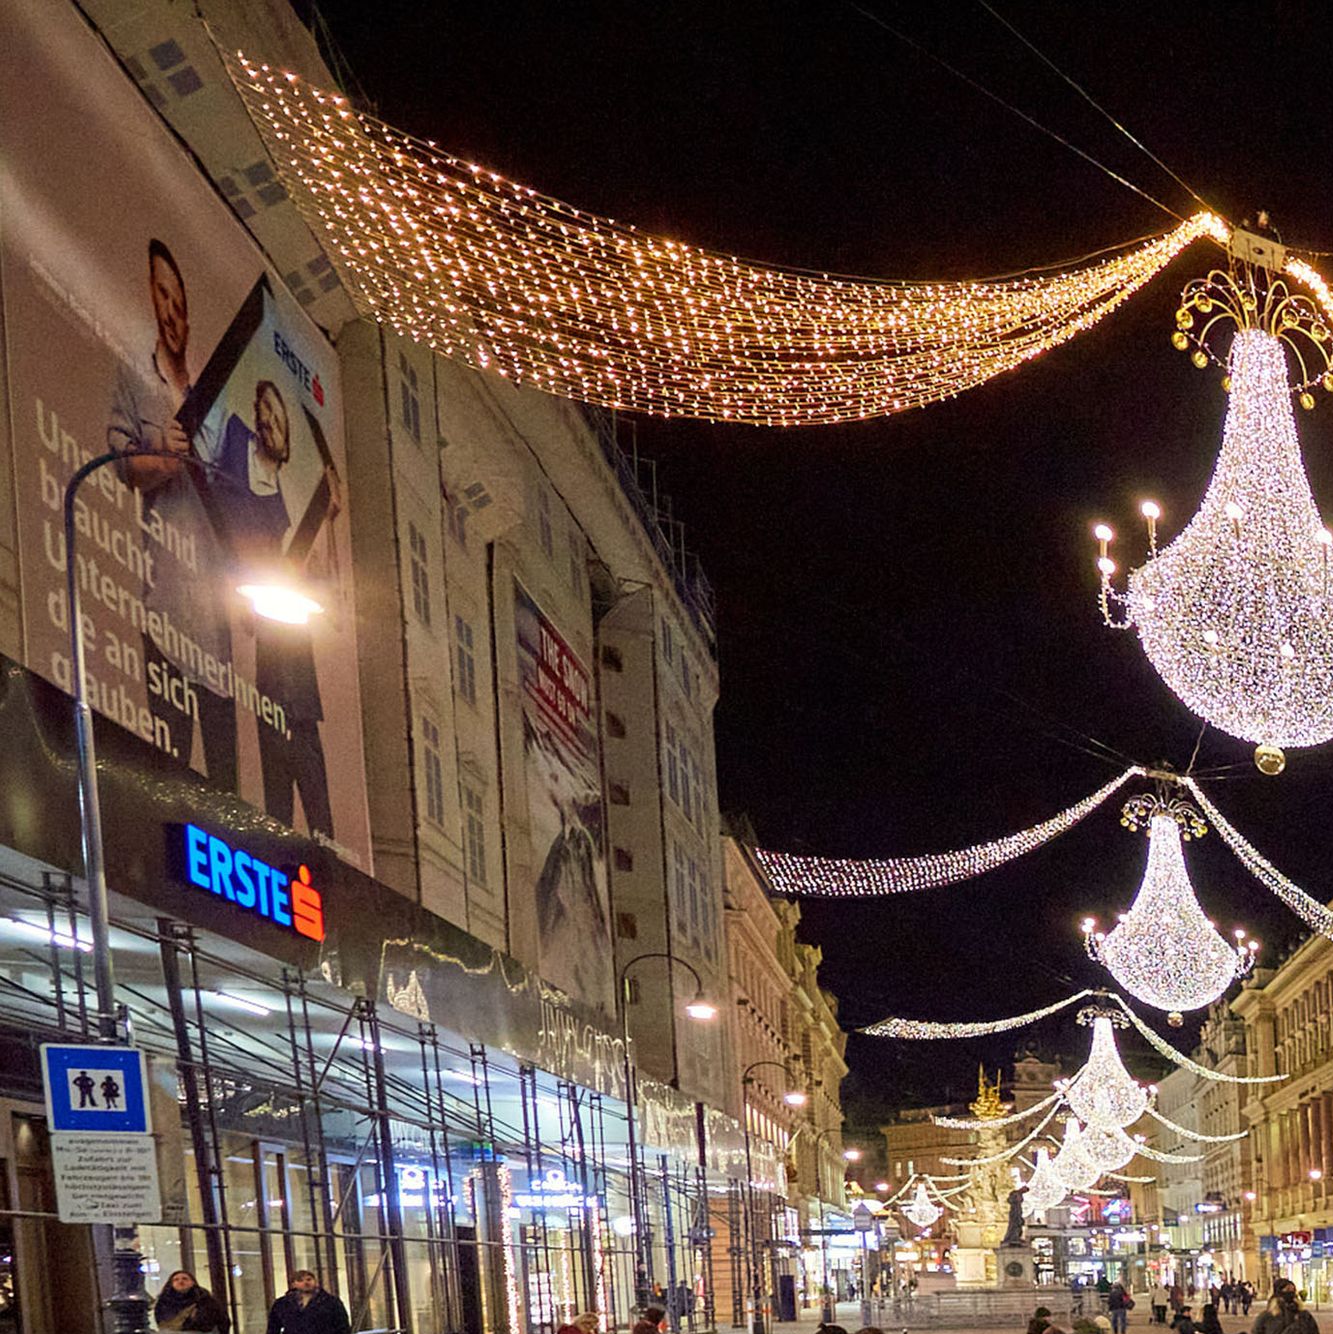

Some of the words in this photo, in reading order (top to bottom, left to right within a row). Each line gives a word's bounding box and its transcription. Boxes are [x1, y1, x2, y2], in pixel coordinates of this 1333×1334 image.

[273, 330, 311, 393] ERSTE
[39, 457, 156, 589] baucht
[135, 487, 197, 573] Land
[47, 588, 96, 651] de
[105, 630, 141, 681] an
[148, 660, 200, 722] sich
[52, 652, 179, 758] gauben.
[186, 823, 292, 927] ERSTE
